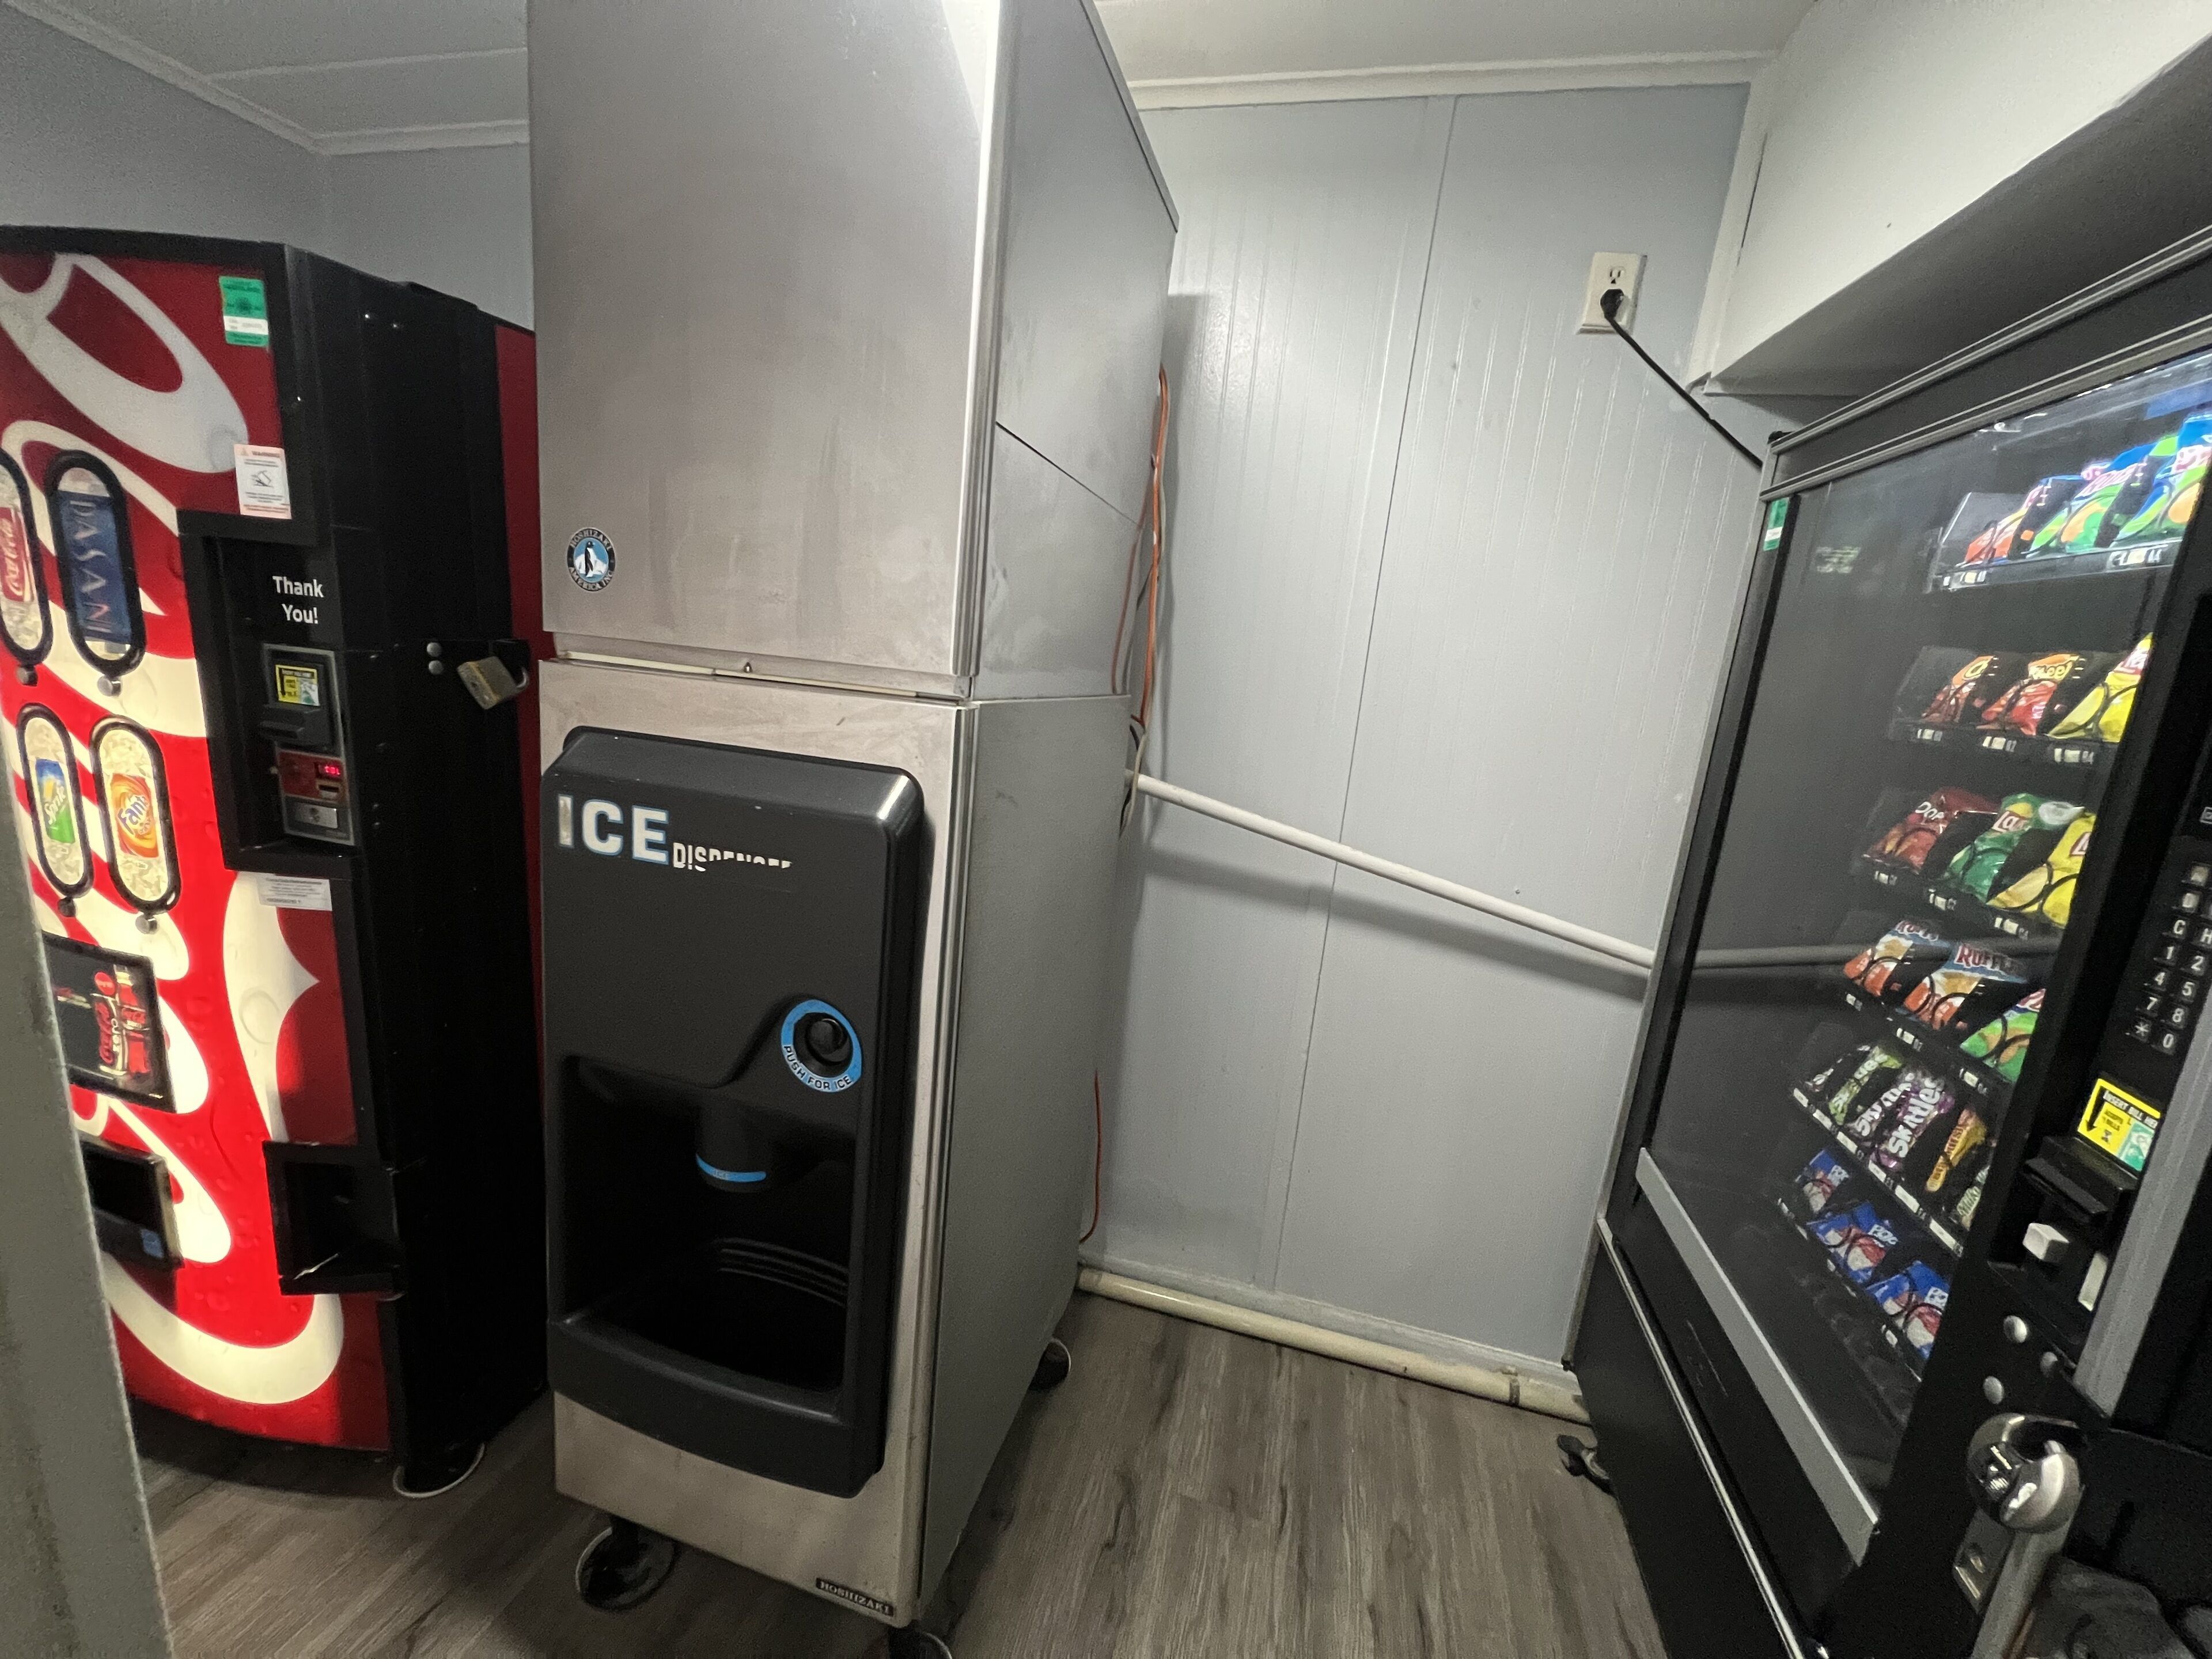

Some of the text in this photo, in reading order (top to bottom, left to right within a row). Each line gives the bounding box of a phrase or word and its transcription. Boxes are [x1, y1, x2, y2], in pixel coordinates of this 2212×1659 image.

[570, 529, 612, 550] HOSHIZAKI
[70, 500, 112, 633] DASANI
[272, 576, 324, 598] Thank
[282, 603, 319, 624] You!
[558, 793, 669, 865] ICE
[2166, 946, 2204, 971] 1 2
[2154, 972, 2195, 996] 4 5
[2146, 997, 2184, 1022] 7 8
[2162, 1033, 2174, 1048] 0
[784, 1045, 852, 1090] PUSH FOR ICE
[820, 1581, 890, 1615] HOSHIZAKI
